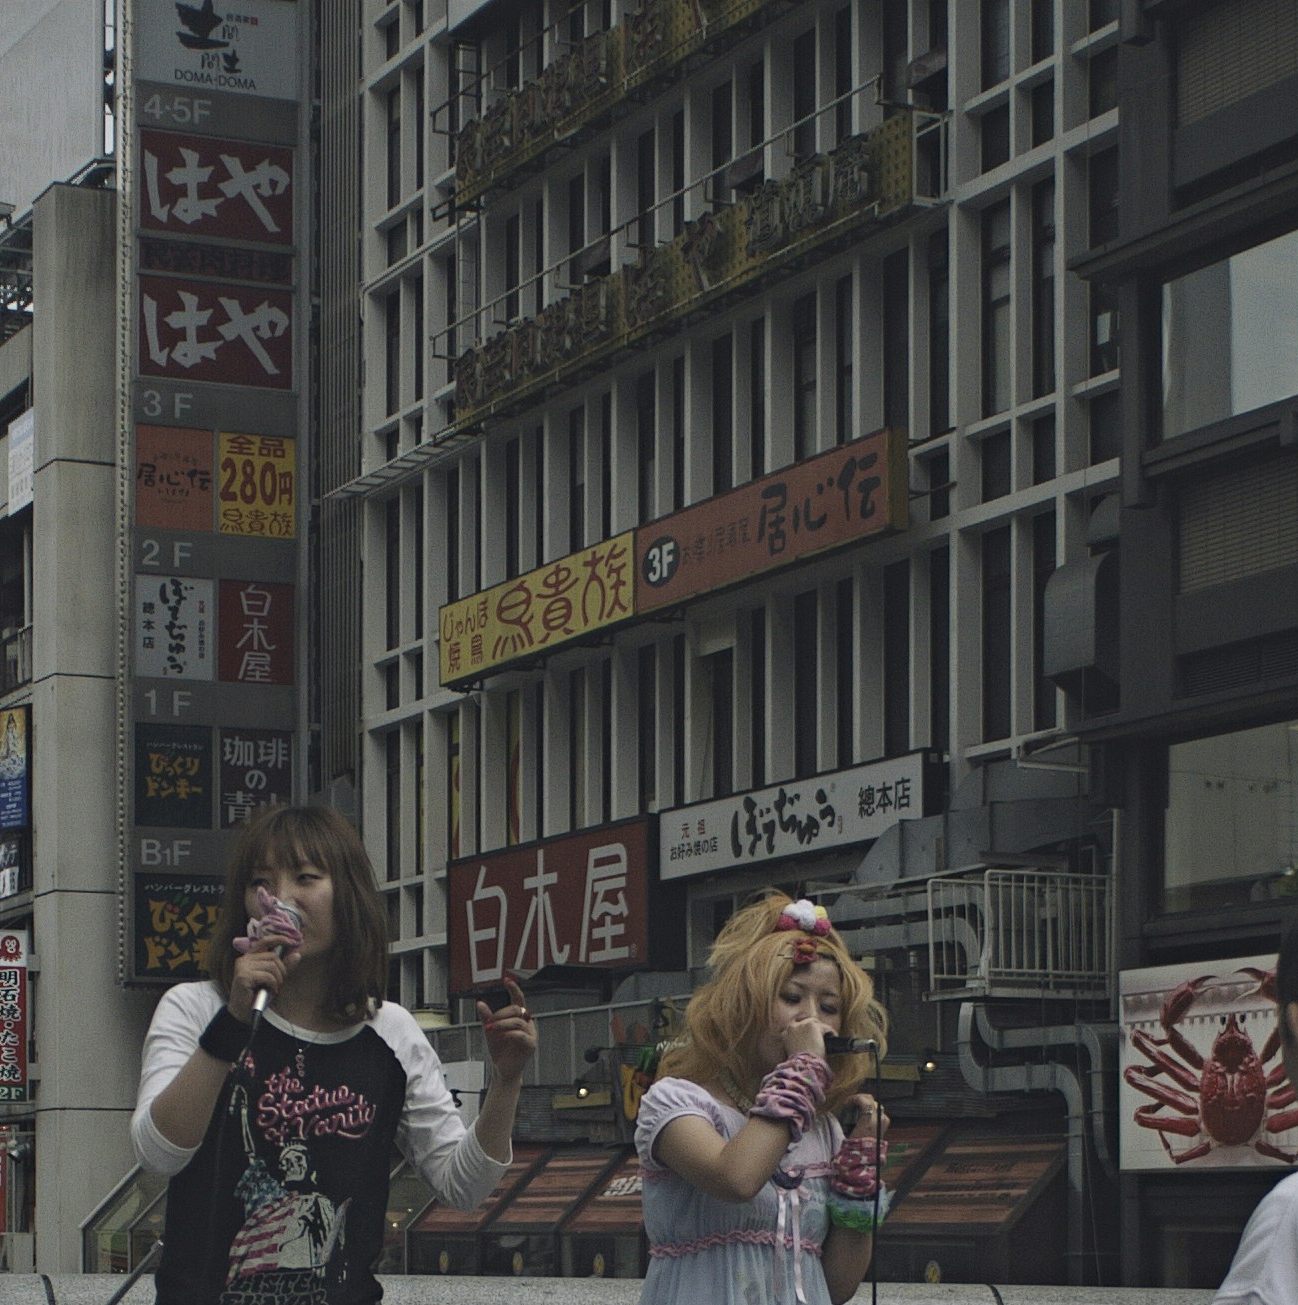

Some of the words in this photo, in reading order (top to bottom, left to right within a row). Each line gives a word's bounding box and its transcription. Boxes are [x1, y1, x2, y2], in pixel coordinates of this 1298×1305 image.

[174, 68, 257, 91] DOMA-DOMA
[143, 147, 291, 233] はや
[143, 291, 291, 375] はや
[226, 434, 286, 459] 全品
[219, 457, 294, 506] 280円
[220, 508, 294, 538] 鳥貴族
[757, 450, 882, 557] 居心伝
[646, 541, 675, 585] 3F
[491, 543, 632, 661] 鳥貴族
[235, 584, 277, 683] 白木屋
[148, 751, 201, 777] びっくり
[223, 735, 290, 769] 珈琲
[144, 775, 204, 800] ドンキー
[245, 769, 267, 790] の
[140, 838, 193, 868] B1F
[465, 842, 631, 984] 白木屋
[265, 1066, 305, 1094] the
[257, 1085, 357, 1128] Statue
[297, 1095, 378, 1139] Vanity
